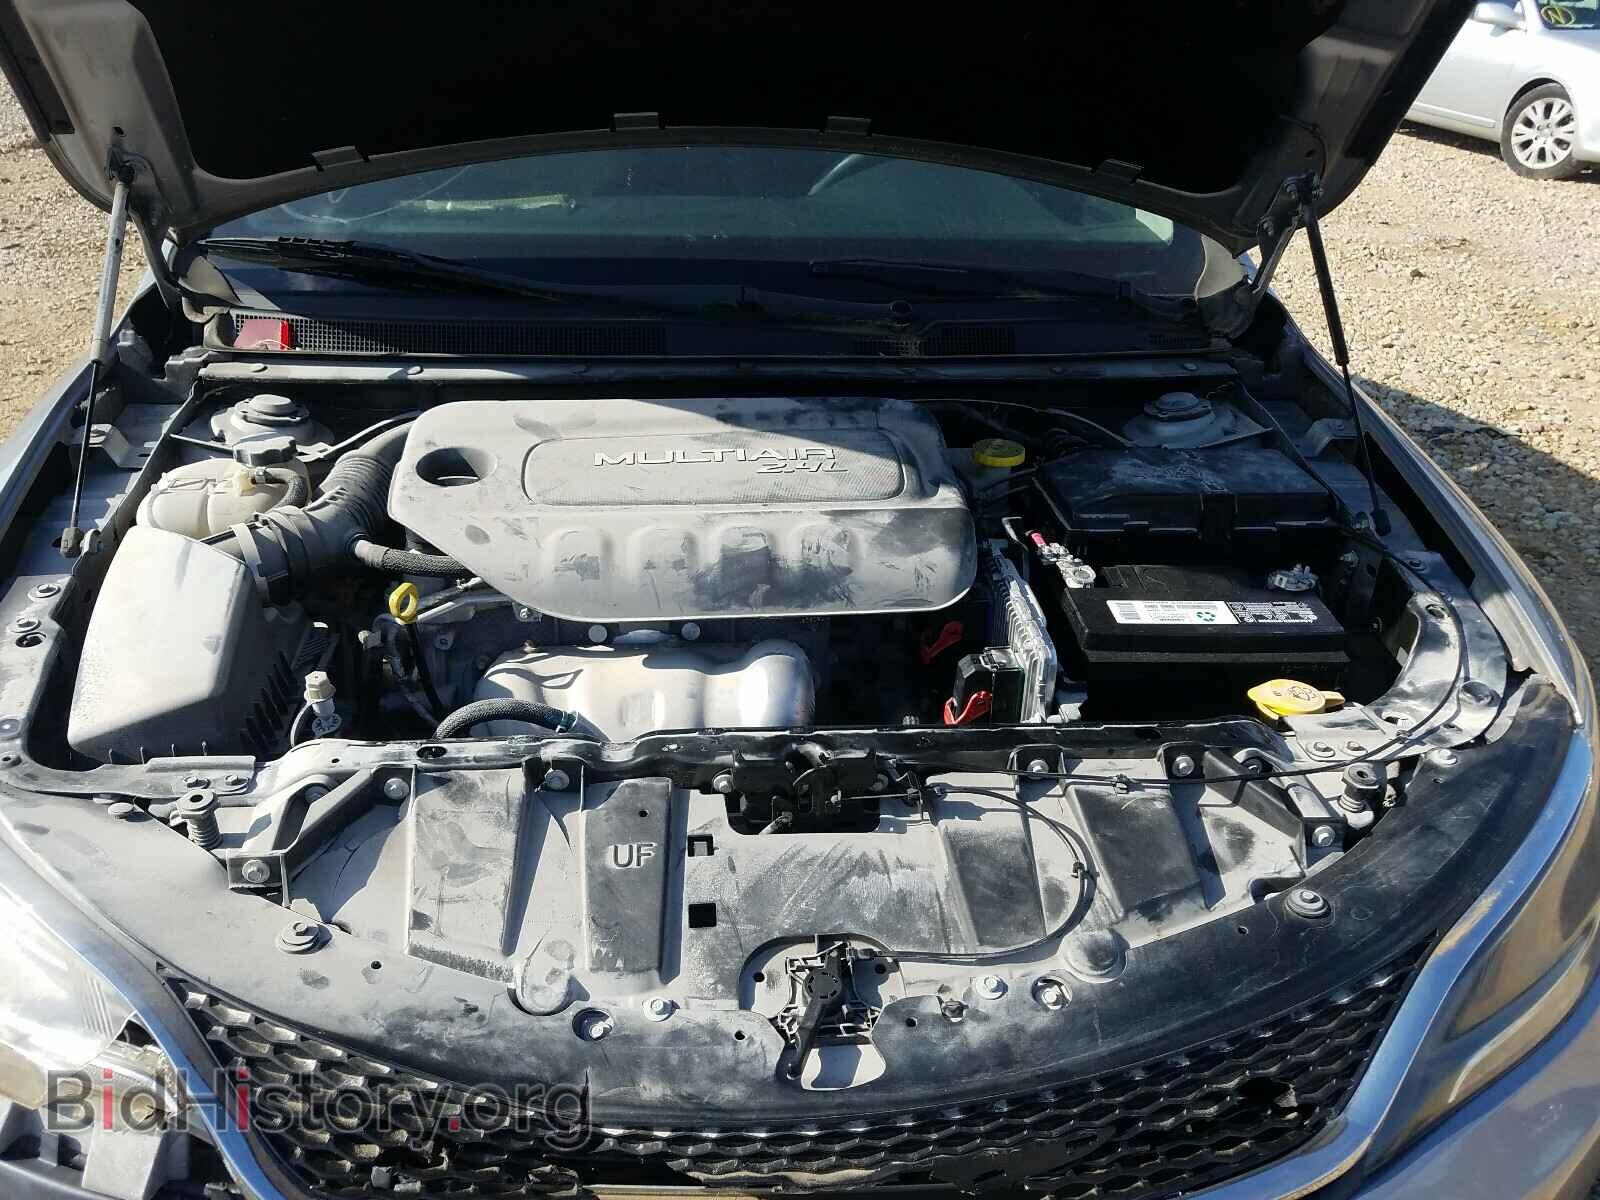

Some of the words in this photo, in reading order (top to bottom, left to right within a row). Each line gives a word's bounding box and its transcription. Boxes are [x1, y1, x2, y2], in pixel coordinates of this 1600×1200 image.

[592, 447, 836, 467] MULTIAIR
[756, 461, 849, 474] 2.4L
[609, 842, 657, 869] UF
